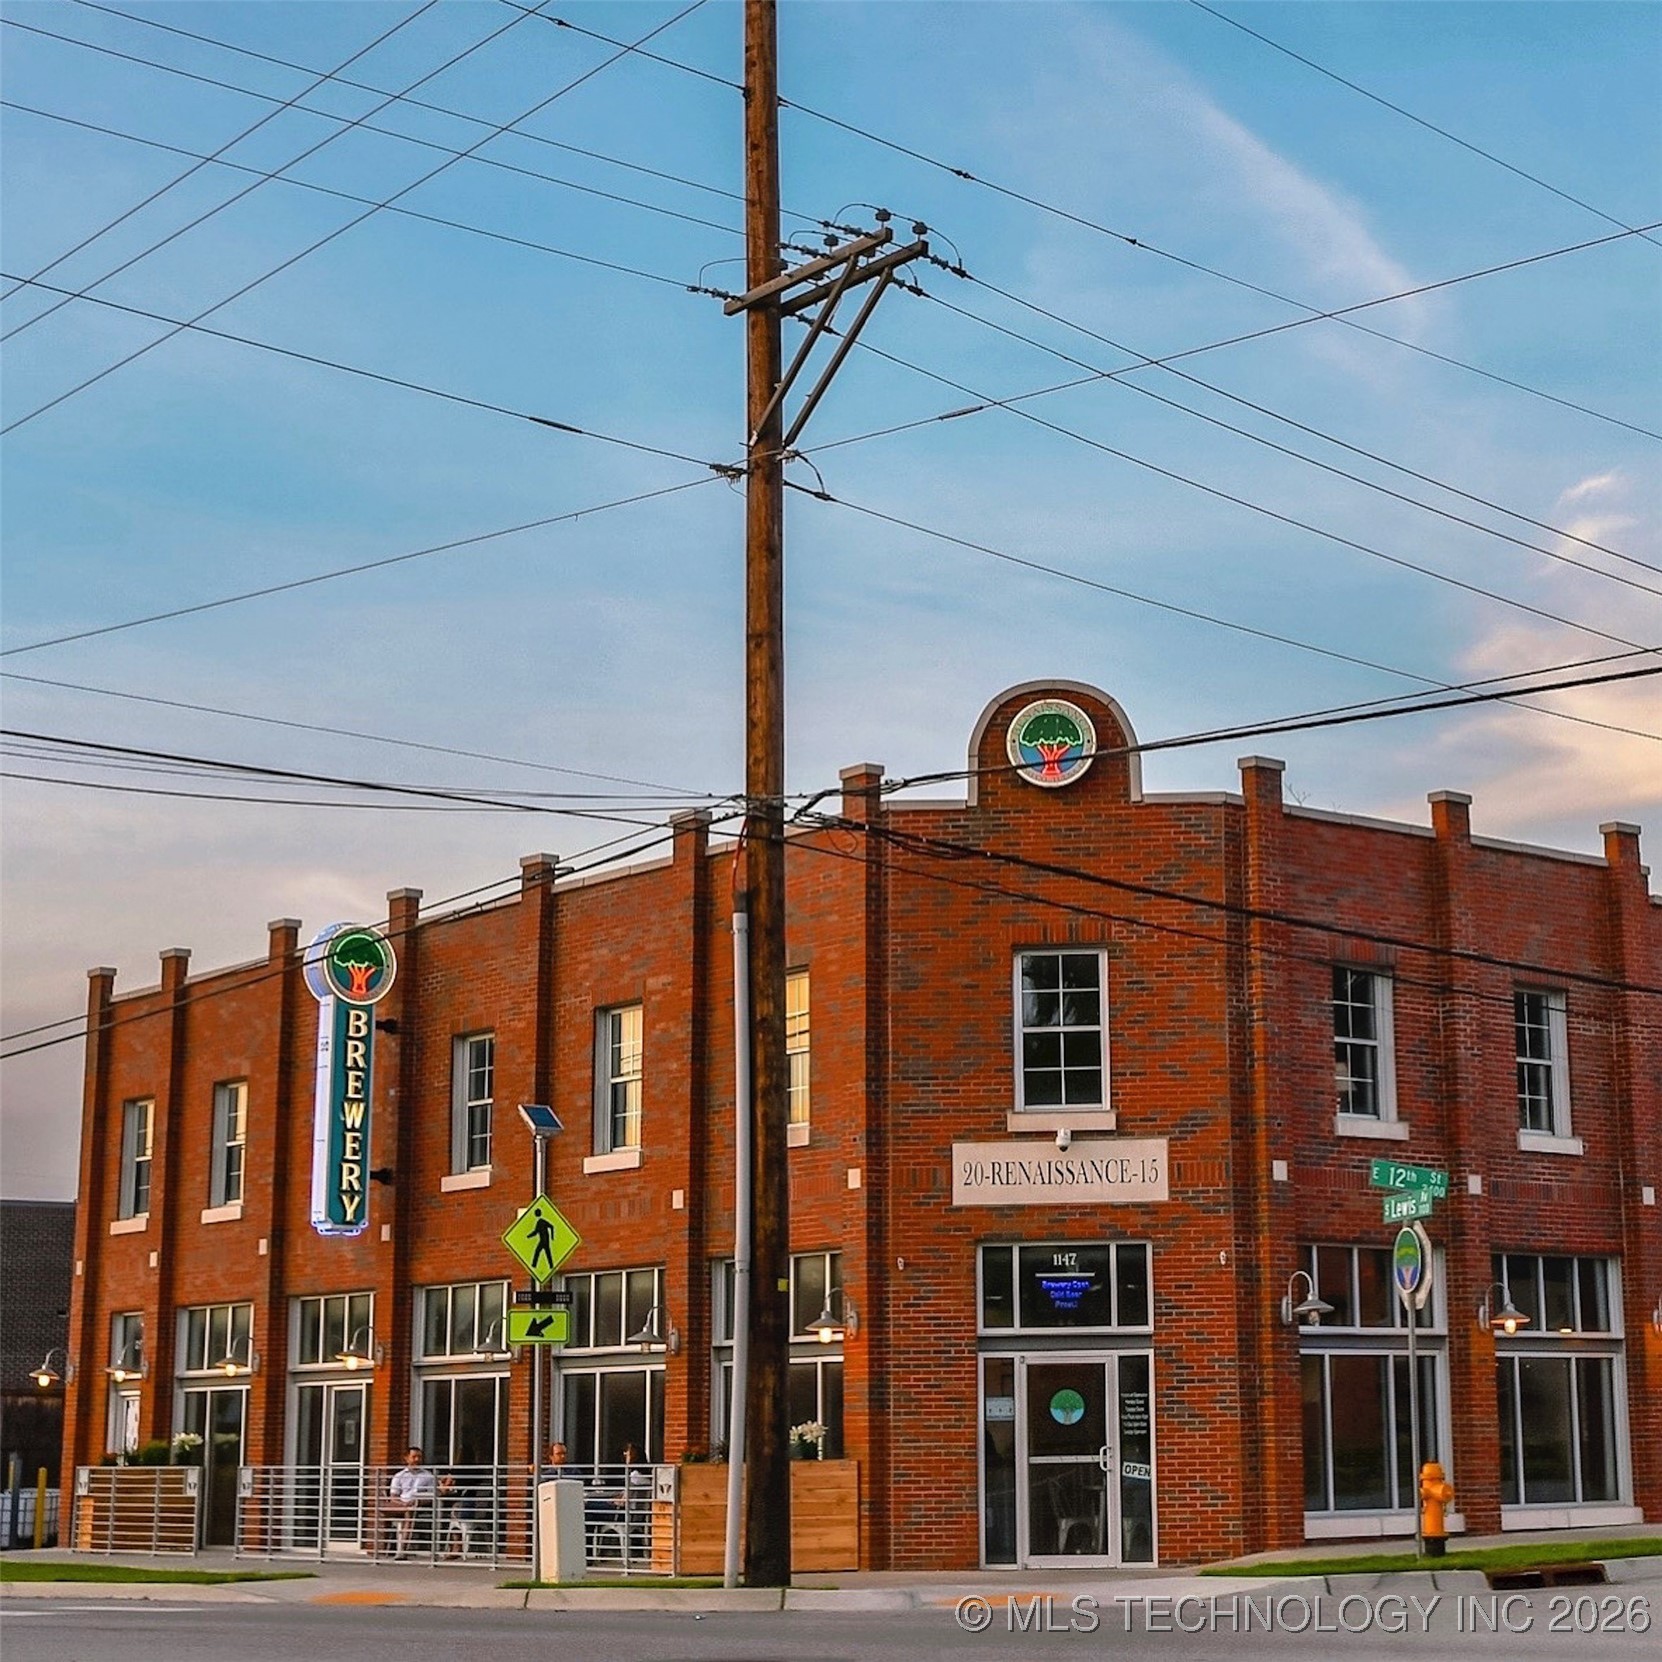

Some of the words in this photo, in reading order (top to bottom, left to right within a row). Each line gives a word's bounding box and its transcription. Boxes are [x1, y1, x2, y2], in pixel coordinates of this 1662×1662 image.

[340, 1009, 369, 1222] BREWERY
[963, 1158, 1159, 1186] 20-RENAISSANCE-15
[1373, 1167, 1380, 1179] E
[1389, 1167, 1417, 1188] 12th
[1430, 1172, 1441, 1184] St
[1384, 1203, 1390, 1217] S
[1391, 1196, 1416, 1218] Lewis
[1053, 1253, 1077, 1265] 1147
[1124, 1464, 1150, 1477] OPEN
